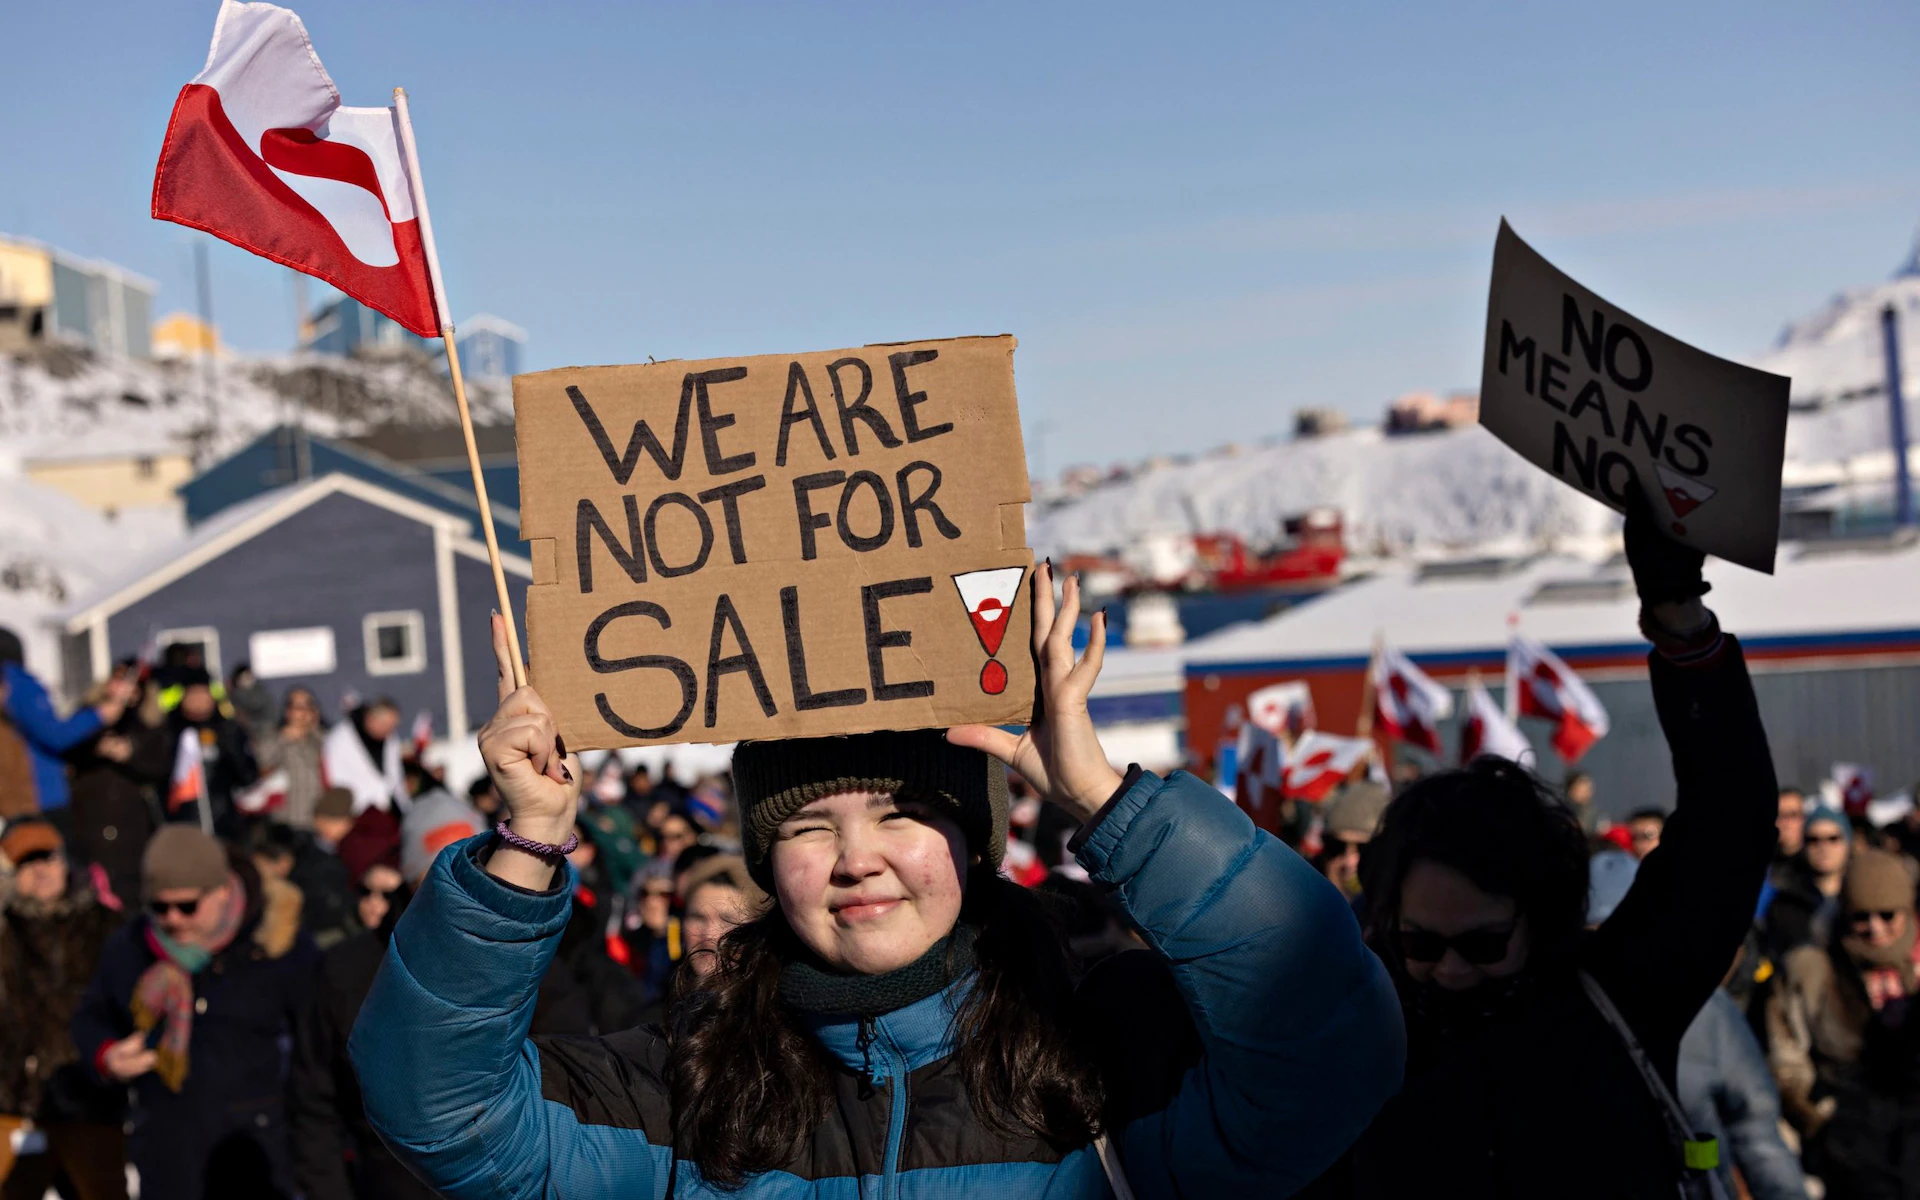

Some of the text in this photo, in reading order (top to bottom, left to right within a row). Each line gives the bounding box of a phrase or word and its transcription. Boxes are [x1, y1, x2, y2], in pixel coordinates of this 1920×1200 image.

[1498, 319, 1713, 477] MEANS
[1561, 293, 1654, 393] NO
[565, 349, 954, 485] WE ARE
[576, 460, 962, 594] NOT FOR
